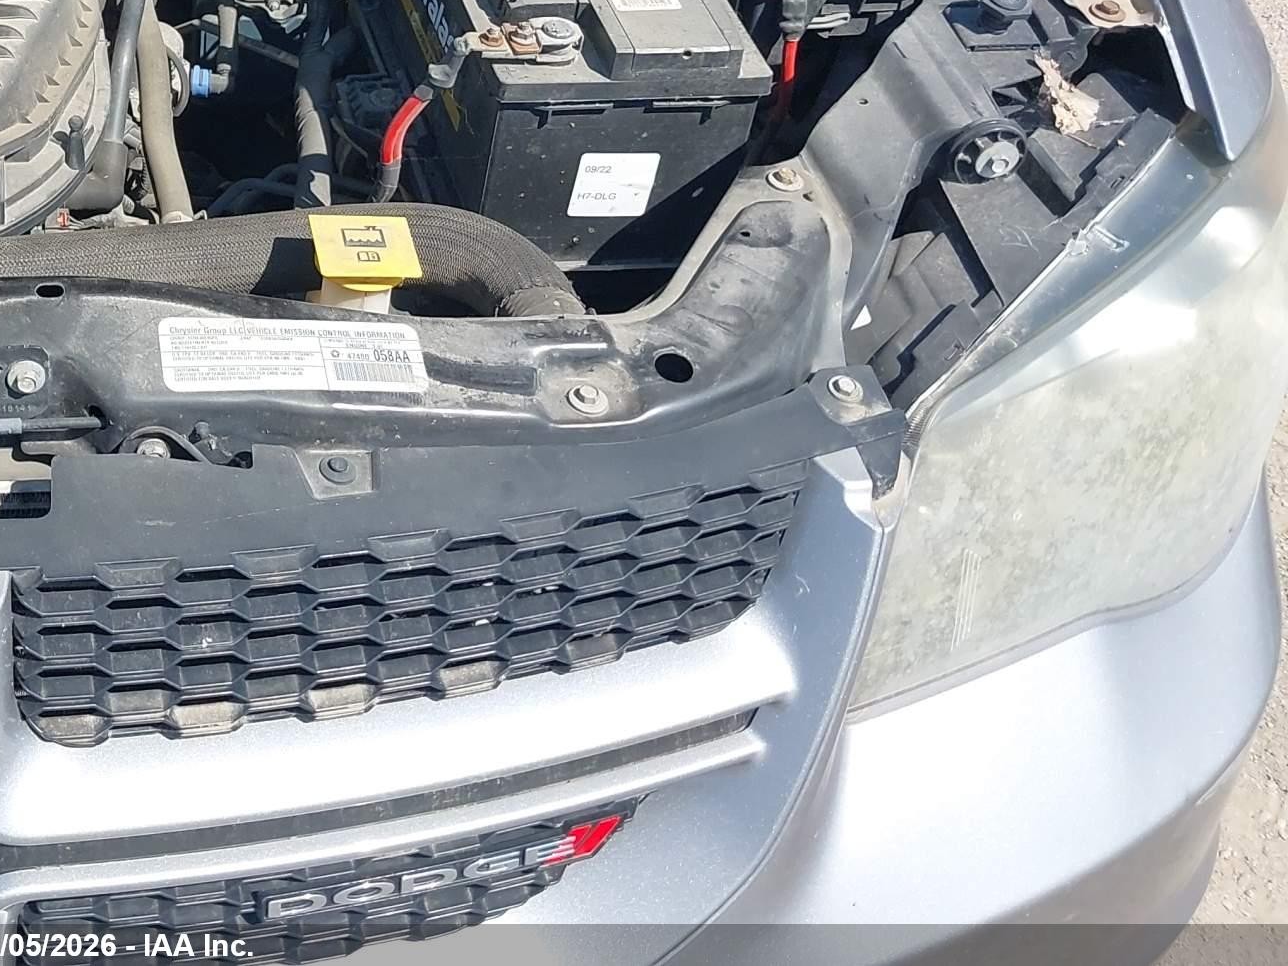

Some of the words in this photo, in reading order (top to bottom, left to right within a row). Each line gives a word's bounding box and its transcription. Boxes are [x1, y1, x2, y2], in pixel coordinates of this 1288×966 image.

[584, 165, 612, 174] 09/22
[576, 192, 617, 201] H7-DLG
[169, 326, 201, 336] Chrysler
[203, 326, 227, 336] Group
[246, 326, 276, 336] VEHICLE
[279, 327, 316, 337] EMISSION
[317, 329, 351, 338] CONTROL
[354, 330, 406, 339] INFORMATION
[373, 349, 411, 362] 058AA
[265, 835, 576, 919] DODGE
